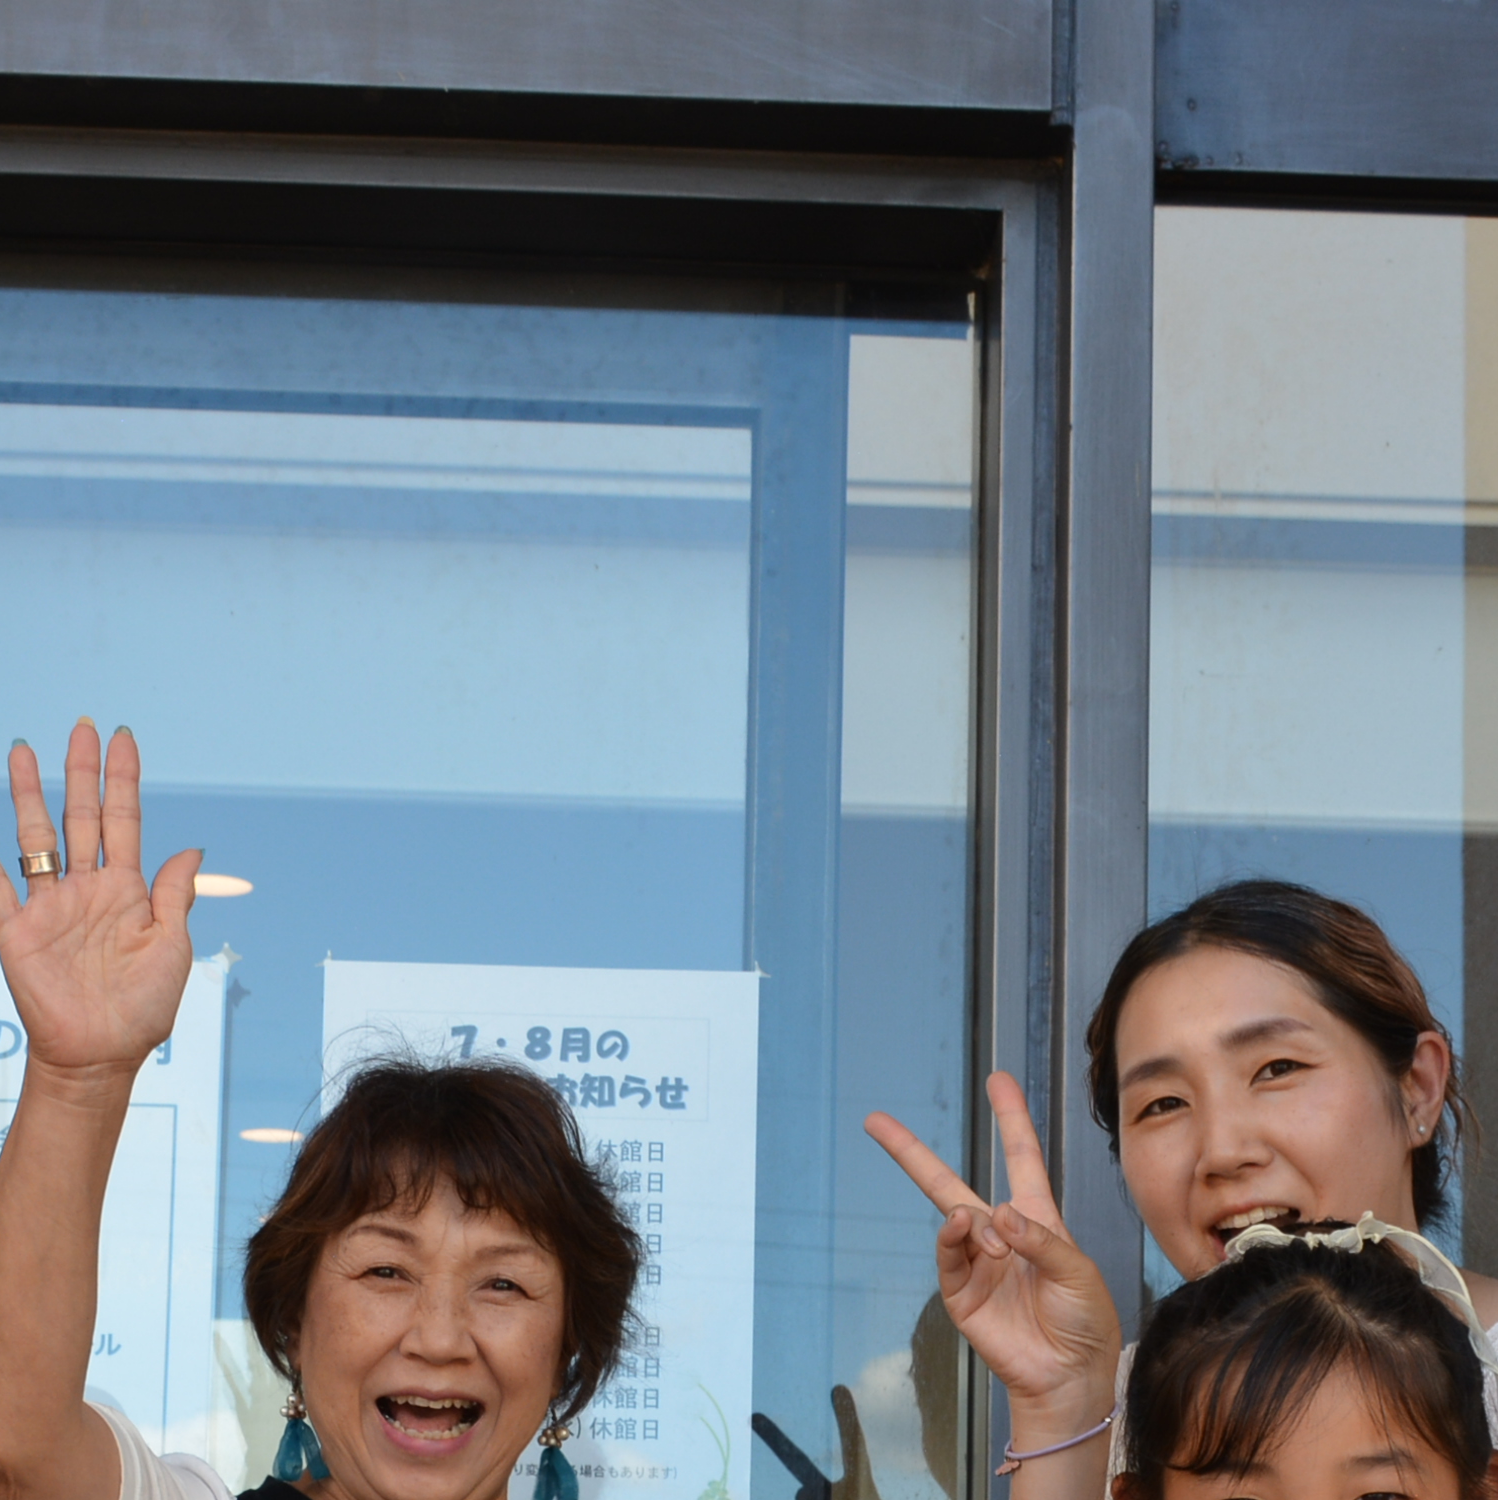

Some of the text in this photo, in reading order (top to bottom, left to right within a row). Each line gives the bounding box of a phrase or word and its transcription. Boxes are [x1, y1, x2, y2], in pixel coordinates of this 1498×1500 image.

[451, 1025, 630, 1063] 7・8月の
[589, 1418, 659, 1440] 休館日
